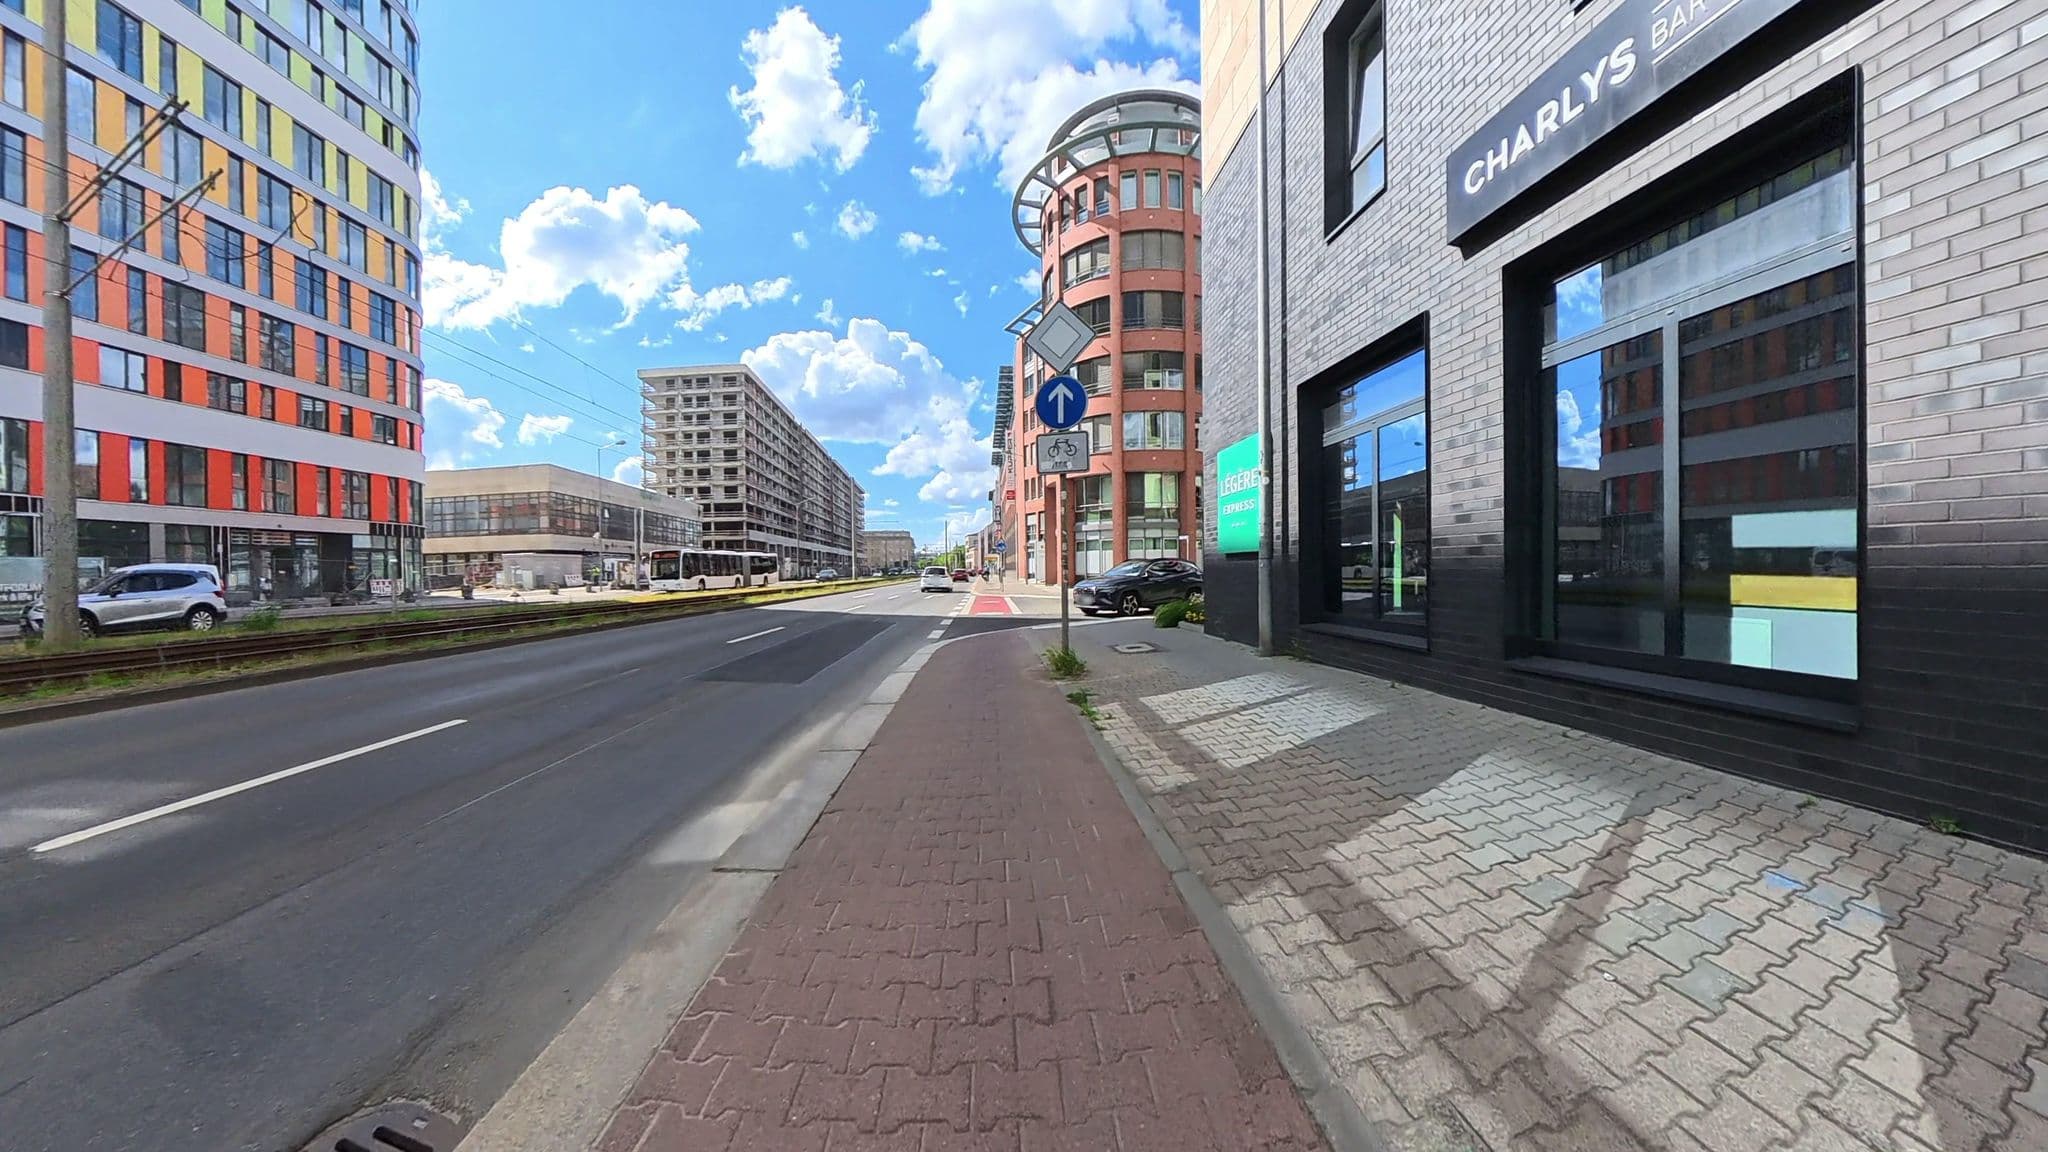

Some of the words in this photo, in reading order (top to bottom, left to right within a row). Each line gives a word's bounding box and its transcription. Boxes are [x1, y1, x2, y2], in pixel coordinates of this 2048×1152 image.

[1464, 37, 1638, 195] CHARLYS
[1652, 0, 1706, 50] BAR
[1223, 499, 1255, 515] EXPRESS
